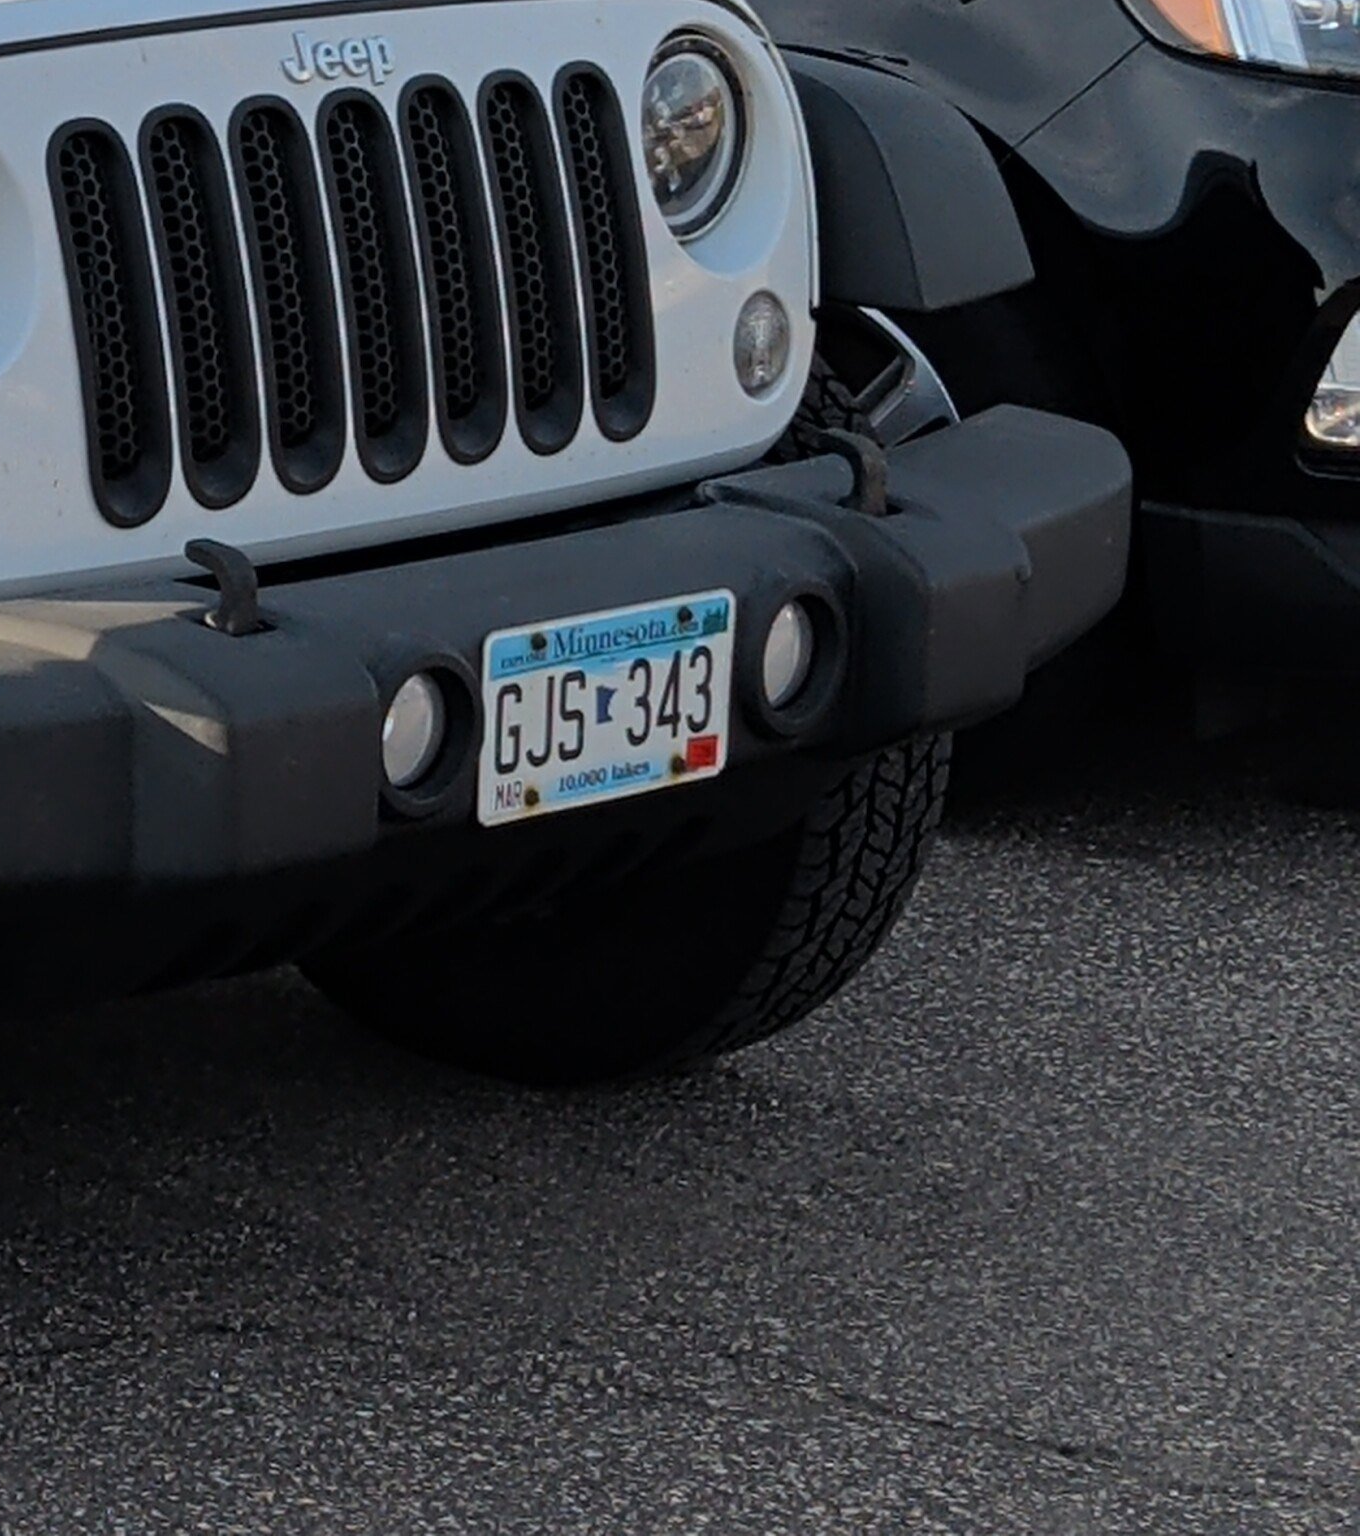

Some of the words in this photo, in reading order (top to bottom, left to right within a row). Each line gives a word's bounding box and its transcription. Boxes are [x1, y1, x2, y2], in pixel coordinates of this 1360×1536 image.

[281, 31, 395, 86] Jeep
[552, 618, 666, 659] Minnesota
[495, 670, 587, 775] GJS
[626, 645, 713, 746] 343
[558, 768, 607, 793] 10,000
[611, 761, 651, 780] lakes
